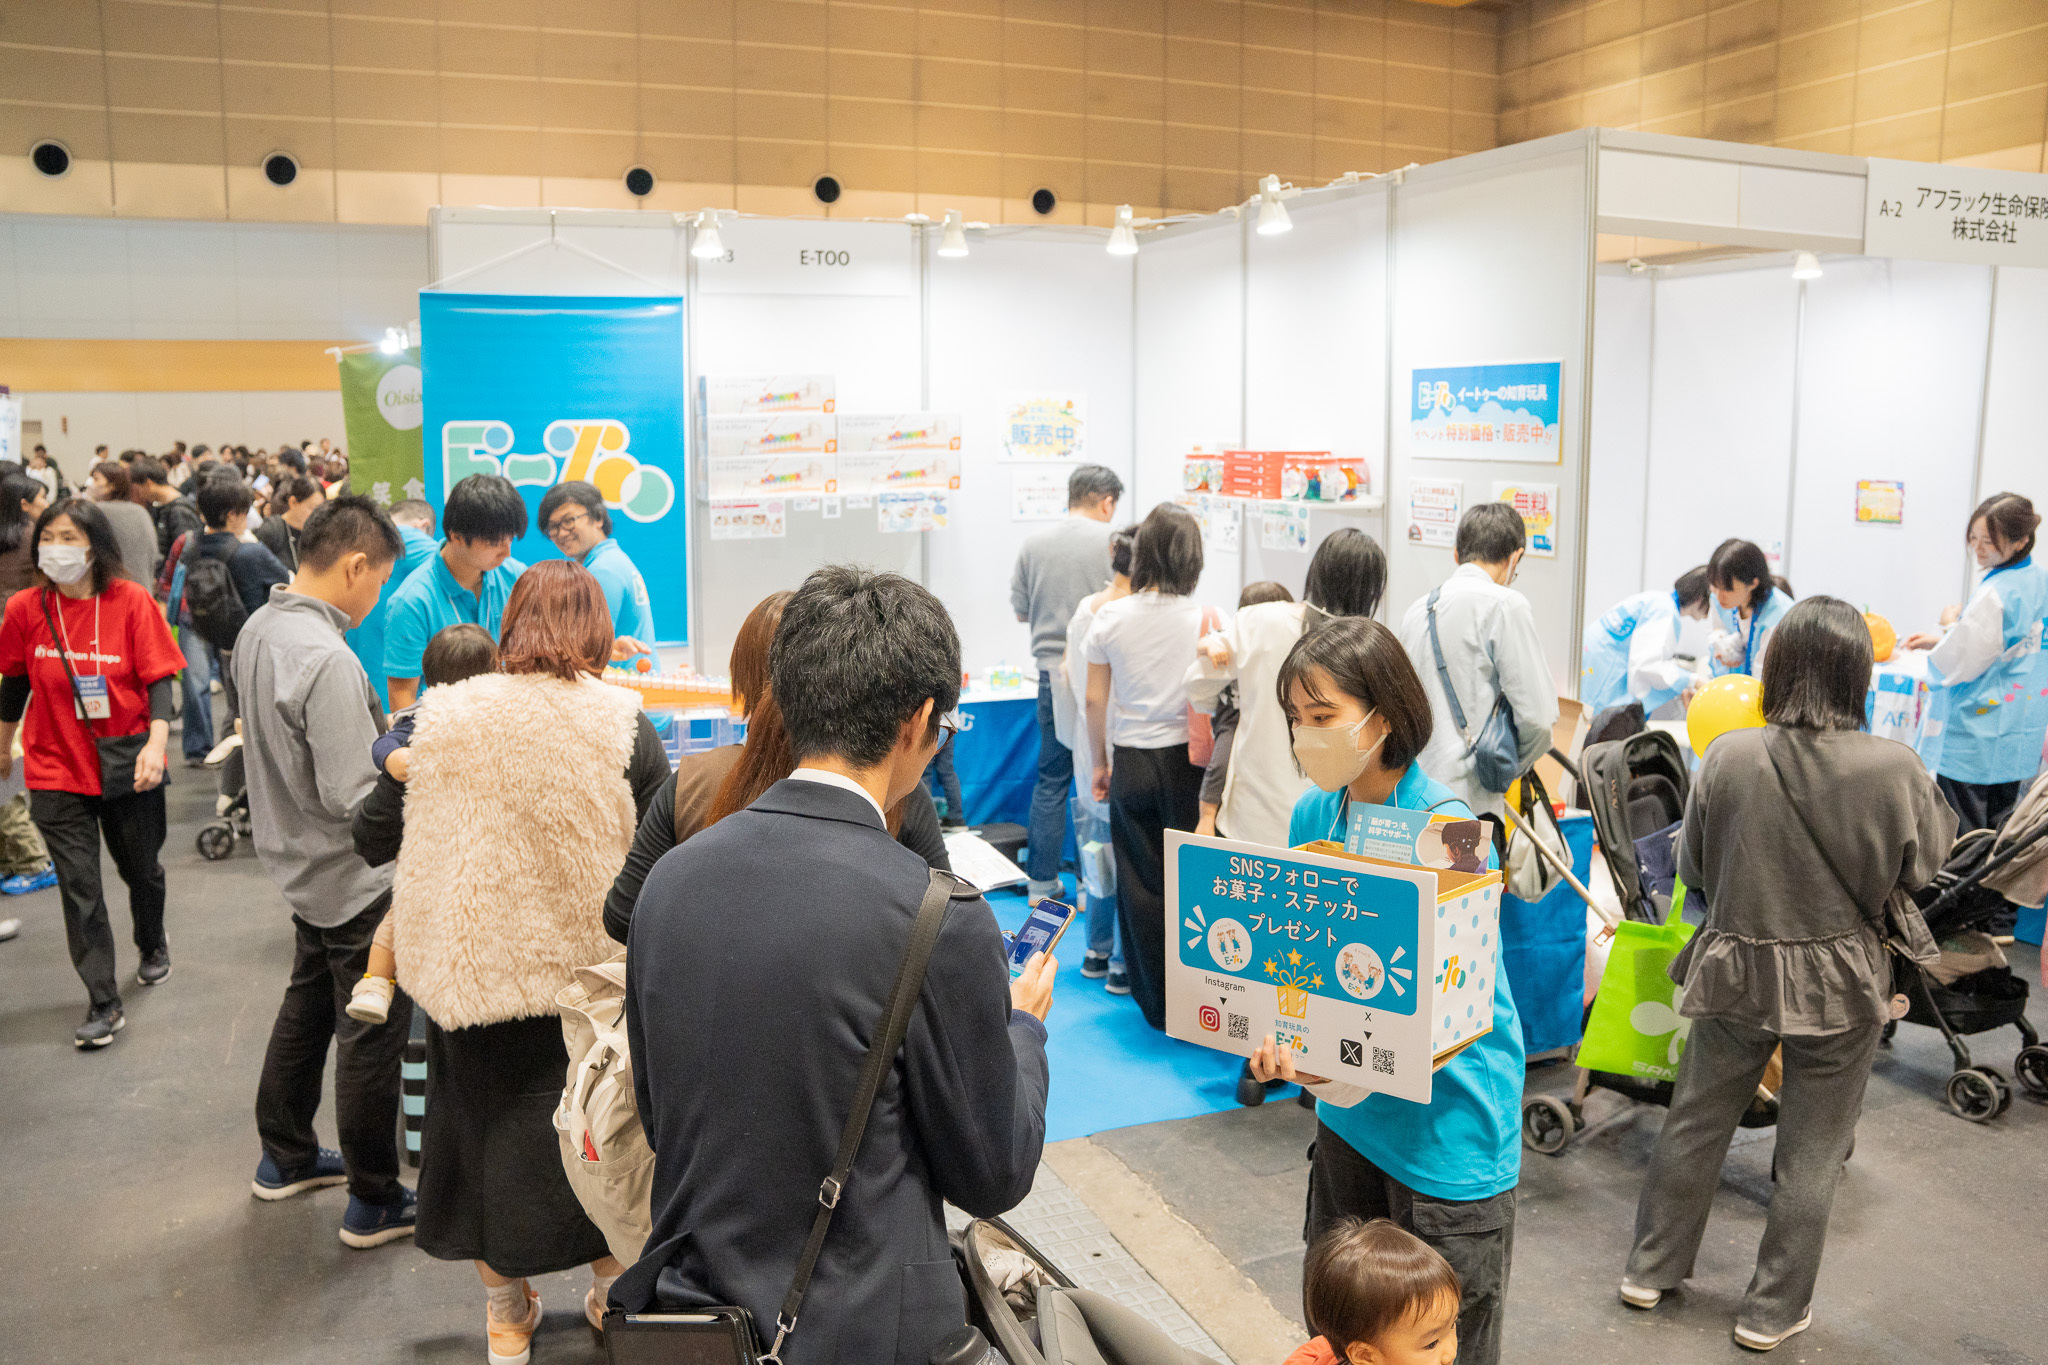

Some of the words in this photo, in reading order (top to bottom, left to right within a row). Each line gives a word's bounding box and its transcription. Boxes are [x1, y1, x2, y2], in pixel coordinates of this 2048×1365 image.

[1880, 200, 1903, 218] A-2
[1952, 216, 2018, 244] 株式会社
[800, 250, 850, 266] E-TOO
[1012, 424, 1075, 446] 販売中
[1368, 827, 1414, 842] 科学でサポート。
[1229, 856, 1360, 897] SNSフォローで
[1212, 876, 1380, 922] お菓子・ステッカー
[1248, 912, 1338, 948] プレゼント
[1205, 976, 1246, 993] Instagram
[1364, 1011, 1372, 1022] X
[1274, 1019, 1310, 1034] 知育玩具の
